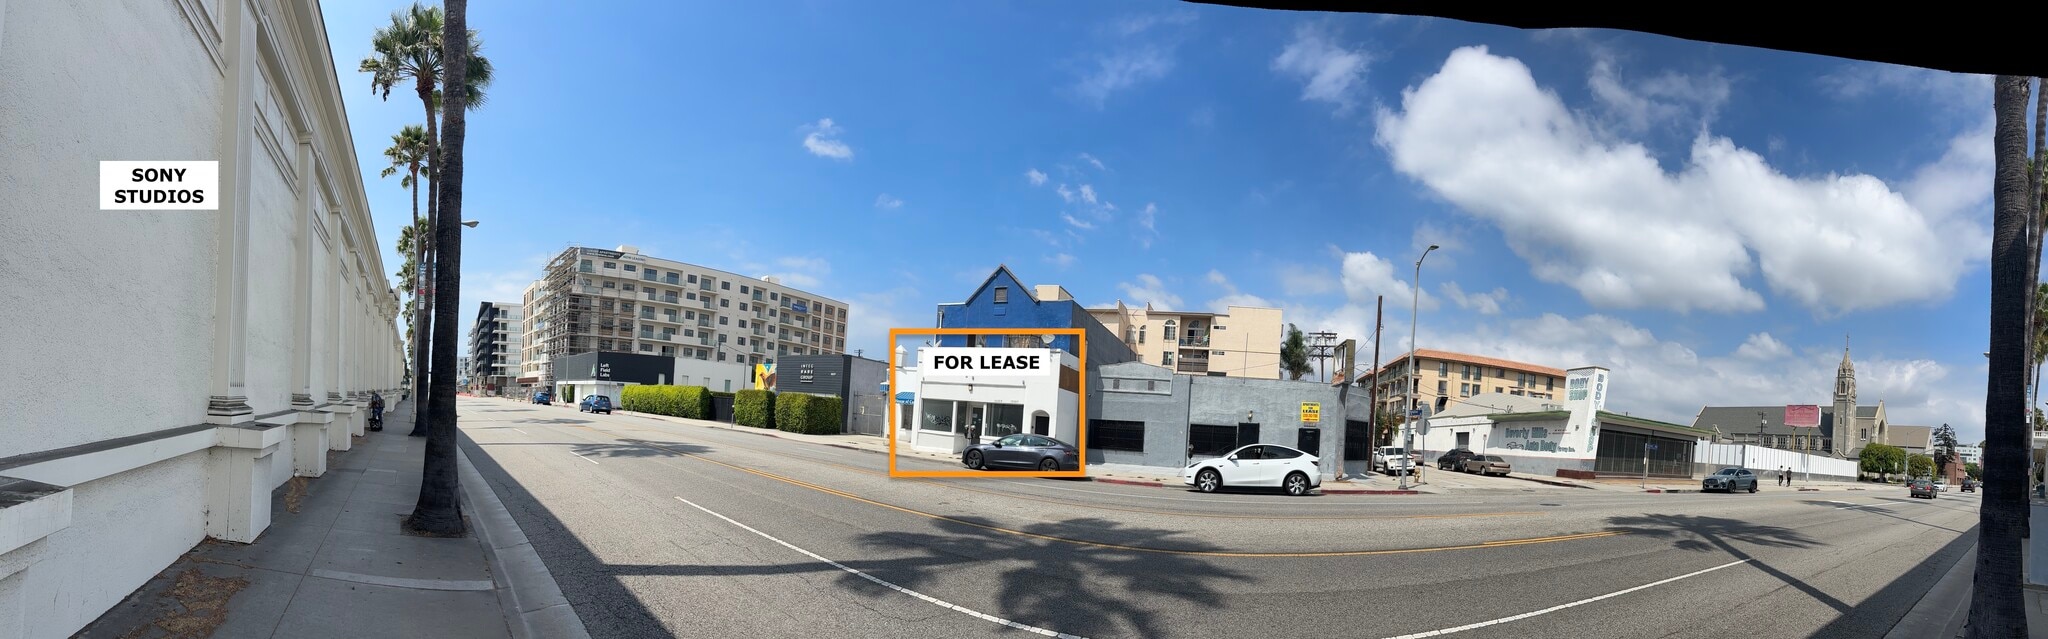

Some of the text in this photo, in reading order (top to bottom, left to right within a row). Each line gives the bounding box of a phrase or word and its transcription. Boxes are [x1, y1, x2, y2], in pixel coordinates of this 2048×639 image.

[1570, 377, 1589, 389] BODY
[1568, 389, 1588, 401] SHOP
[1594, 373, 1605, 410] BODY
[1505, 426, 1548, 439] Beverly Hills
[1525, 440, 1540, 452] Auto
[1540, 440, 1558, 453] Body
